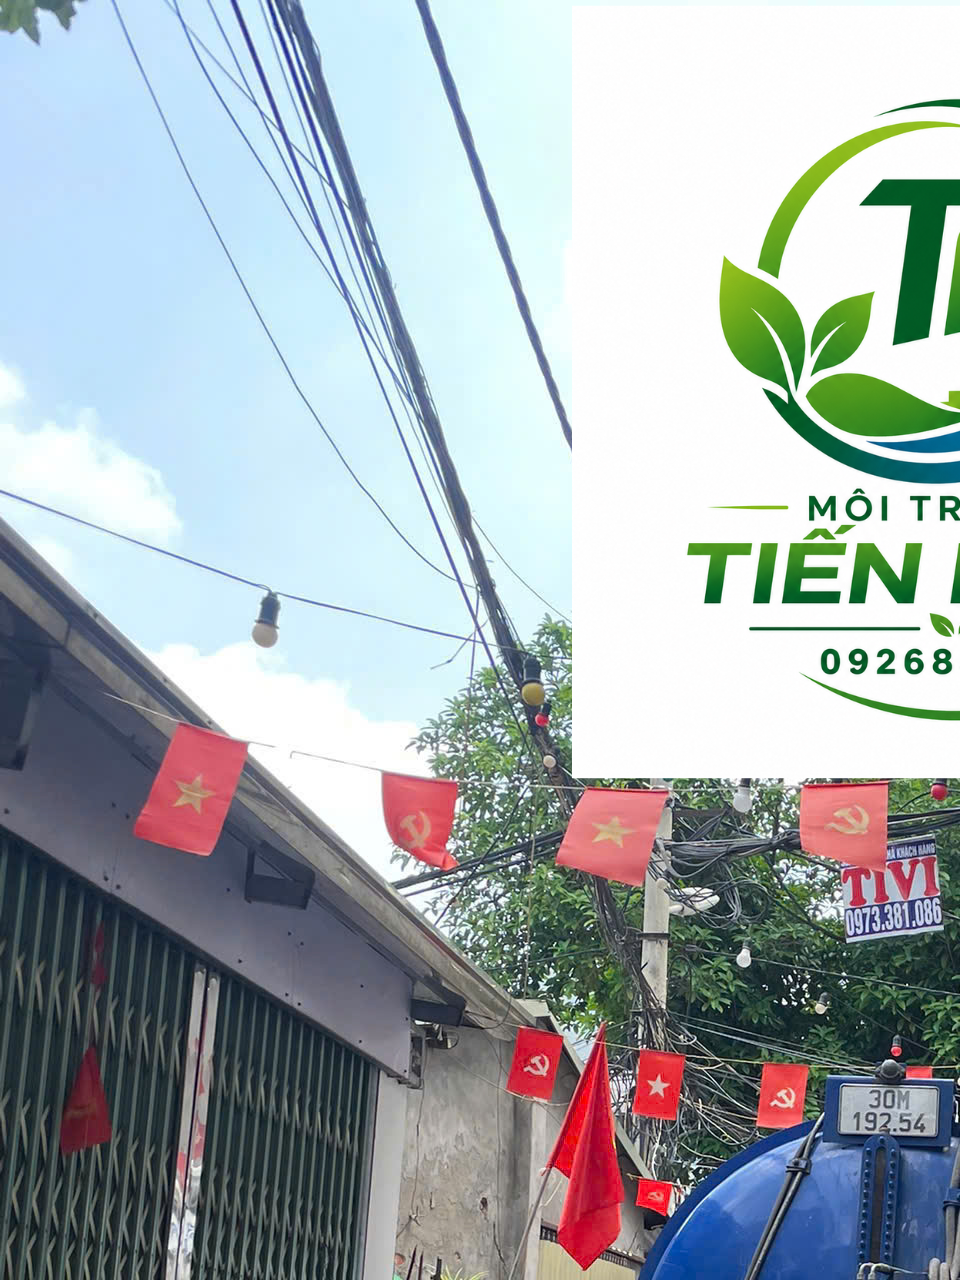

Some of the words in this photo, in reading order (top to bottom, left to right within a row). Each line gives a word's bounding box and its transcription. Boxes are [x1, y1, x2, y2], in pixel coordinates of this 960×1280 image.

[842, 856, 939, 906] TIVI
[845, 898, 942, 936] 0973.381.086
[868, 1089, 911, 1110] 30M
[853, 1111, 926, 1133] 192.54
